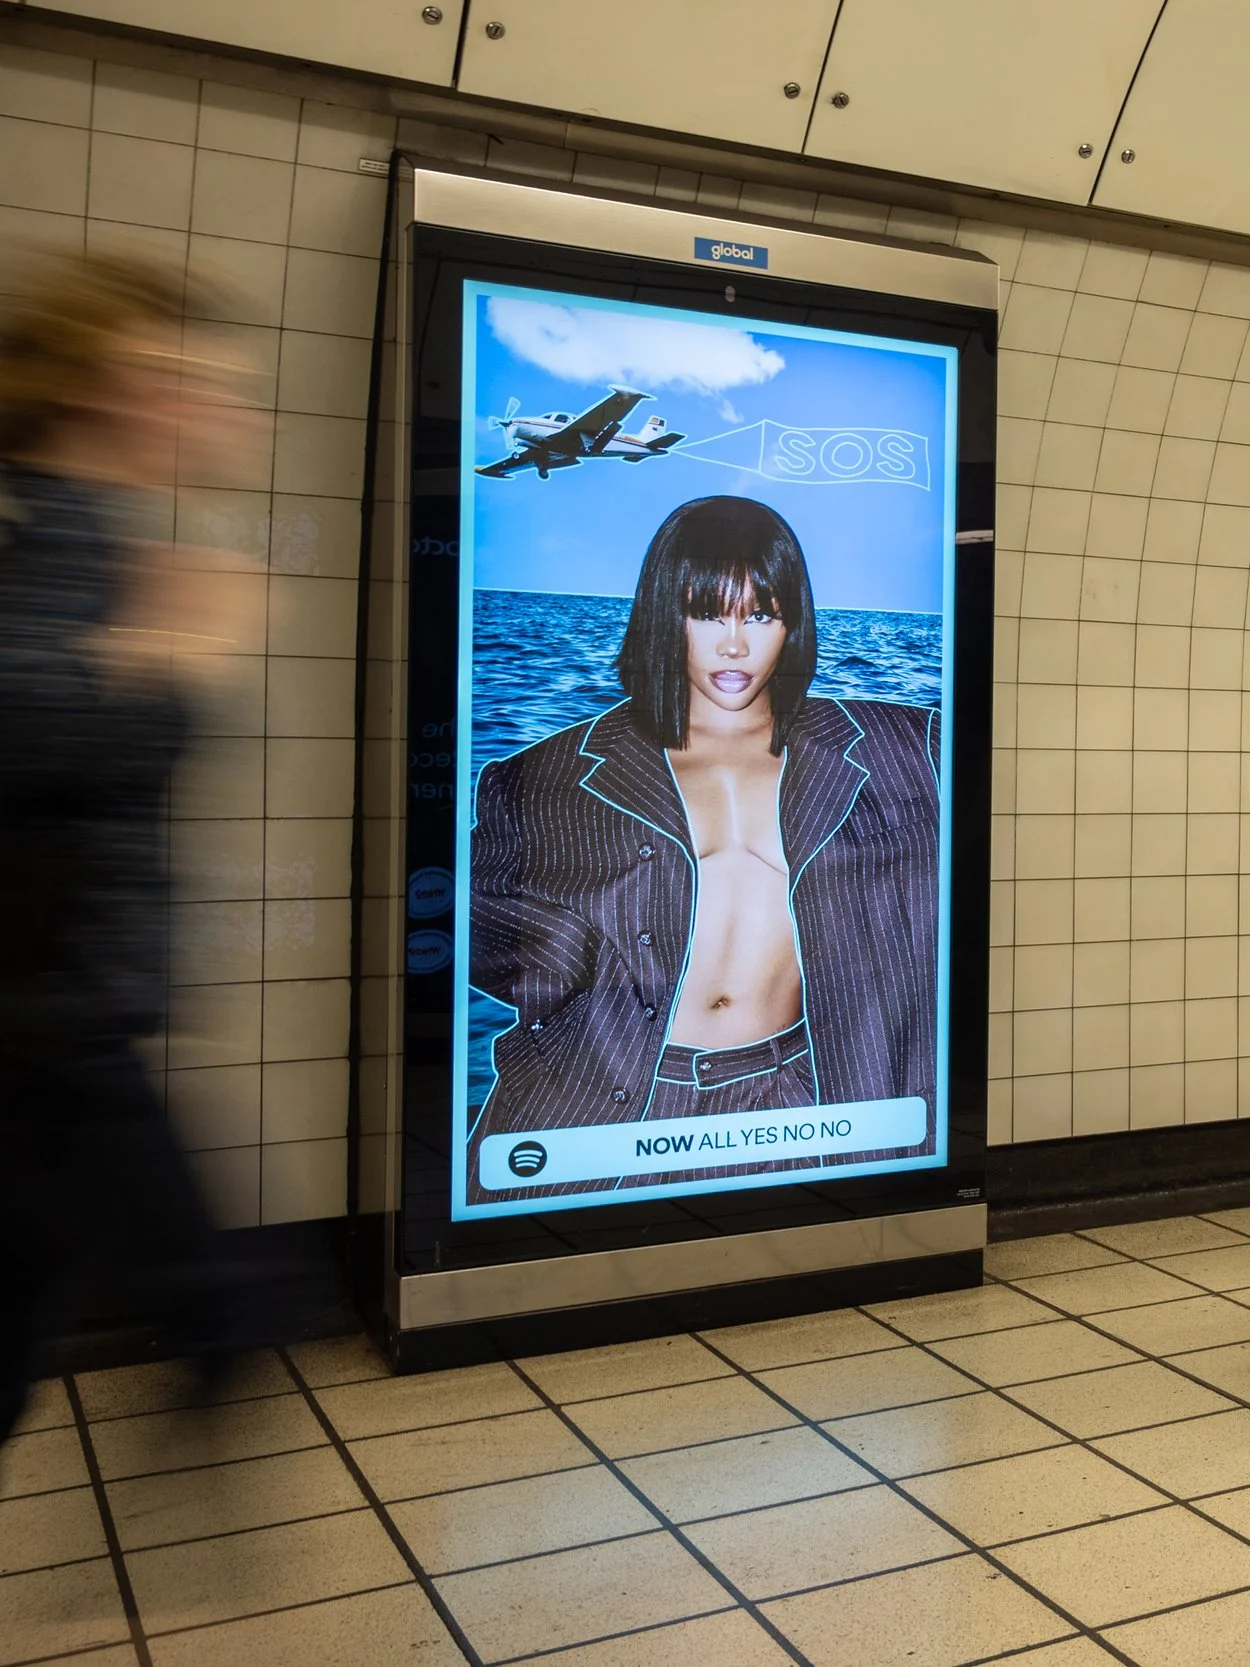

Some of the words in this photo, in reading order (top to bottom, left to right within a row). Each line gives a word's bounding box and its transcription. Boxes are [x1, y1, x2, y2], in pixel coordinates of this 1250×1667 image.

[711, 242, 754, 260] global
[774, 430, 916, 479] SOS
[636, 1134, 694, 1157] NOW
[698, 1131, 737, 1151] ALL
[740, 1126, 778, 1146] YES
[783, 1123, 815, 1142] NO
[820, 1119, 852, 1139] NO
